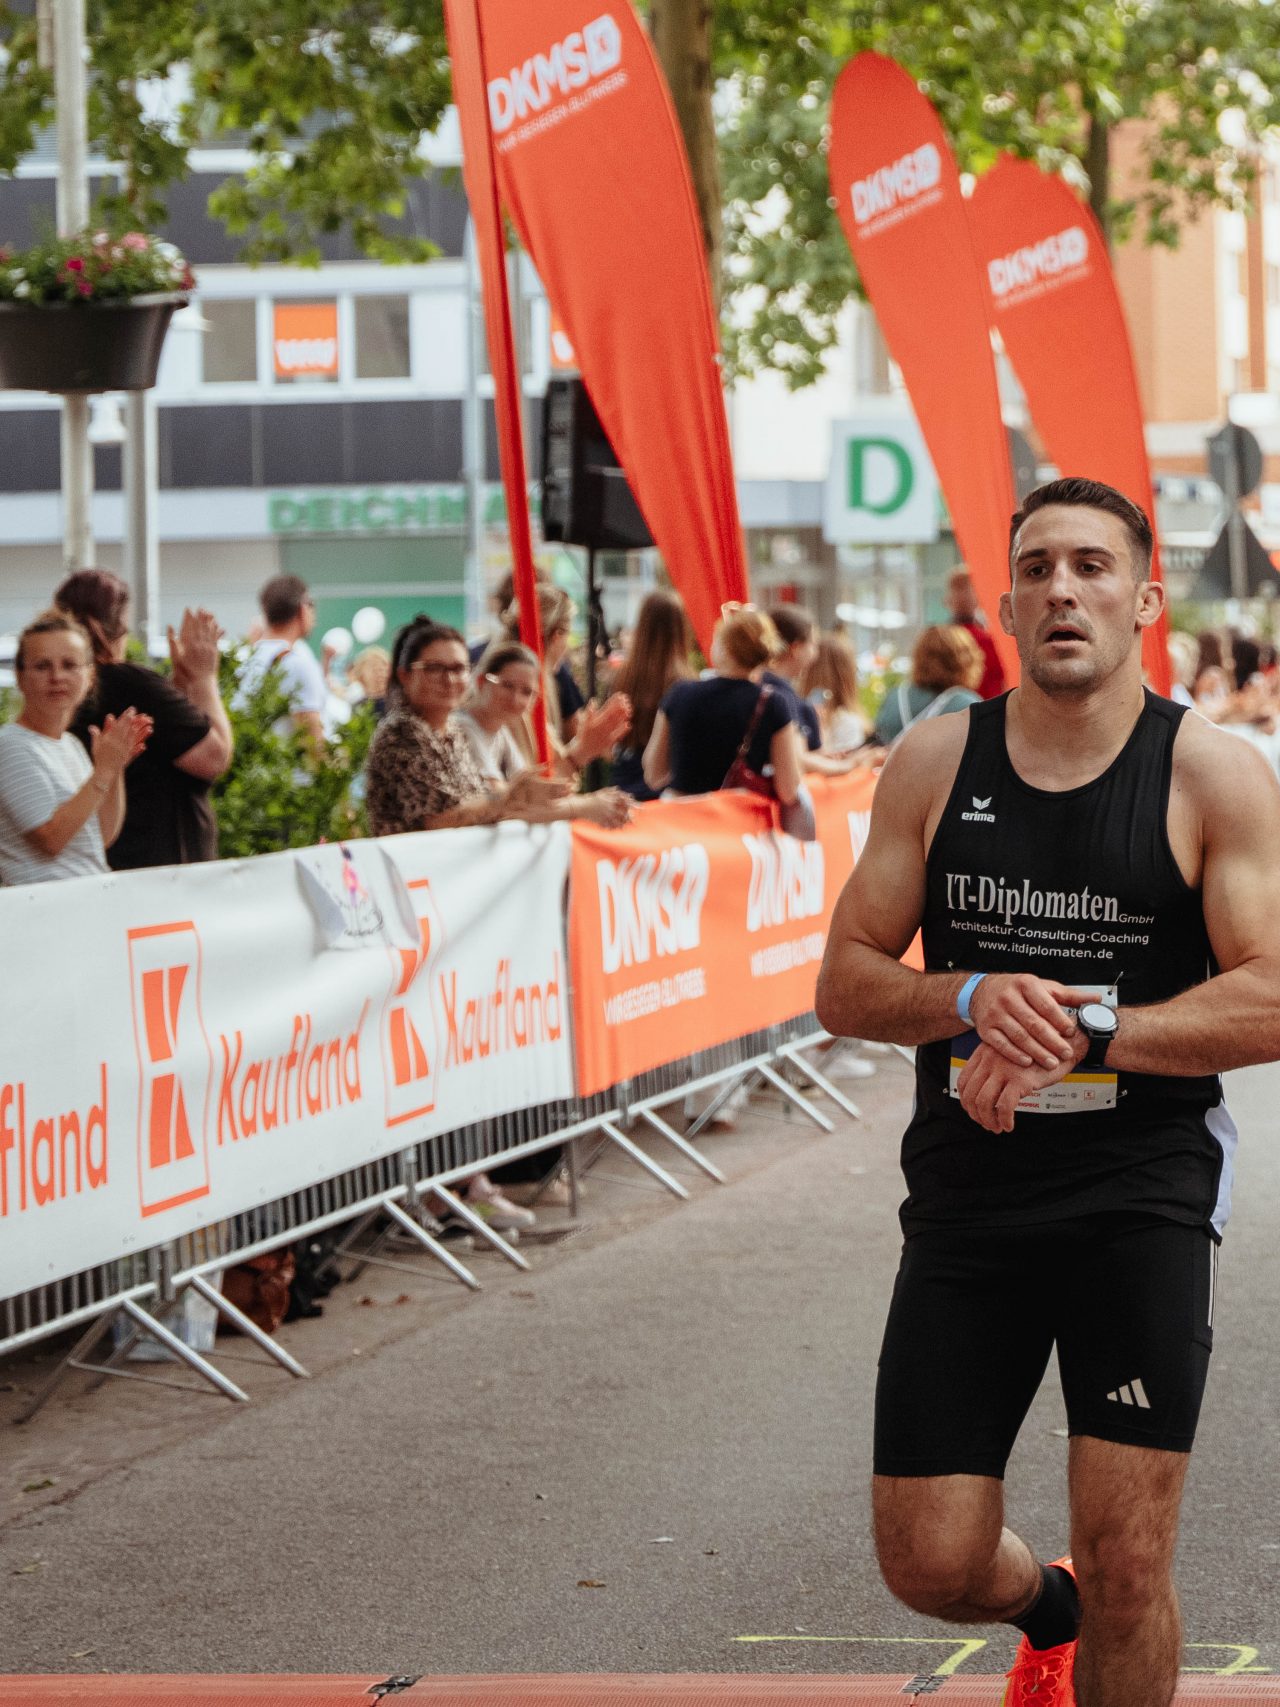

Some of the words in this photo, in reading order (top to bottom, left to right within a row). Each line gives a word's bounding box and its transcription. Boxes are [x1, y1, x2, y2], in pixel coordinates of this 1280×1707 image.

[847, 437, 915, 515] D
[961, 811, 996, 823] erima
[946, 873, 1118, 925] IT-Diplomaten
[1118, 913, 1155, 924] GmbH
[978, 940, 1114, 959] www.itdiplomaten.de
[438, 950, 562, 1071] Kaufland
[217, 996, 372, 1147] Kaufland
